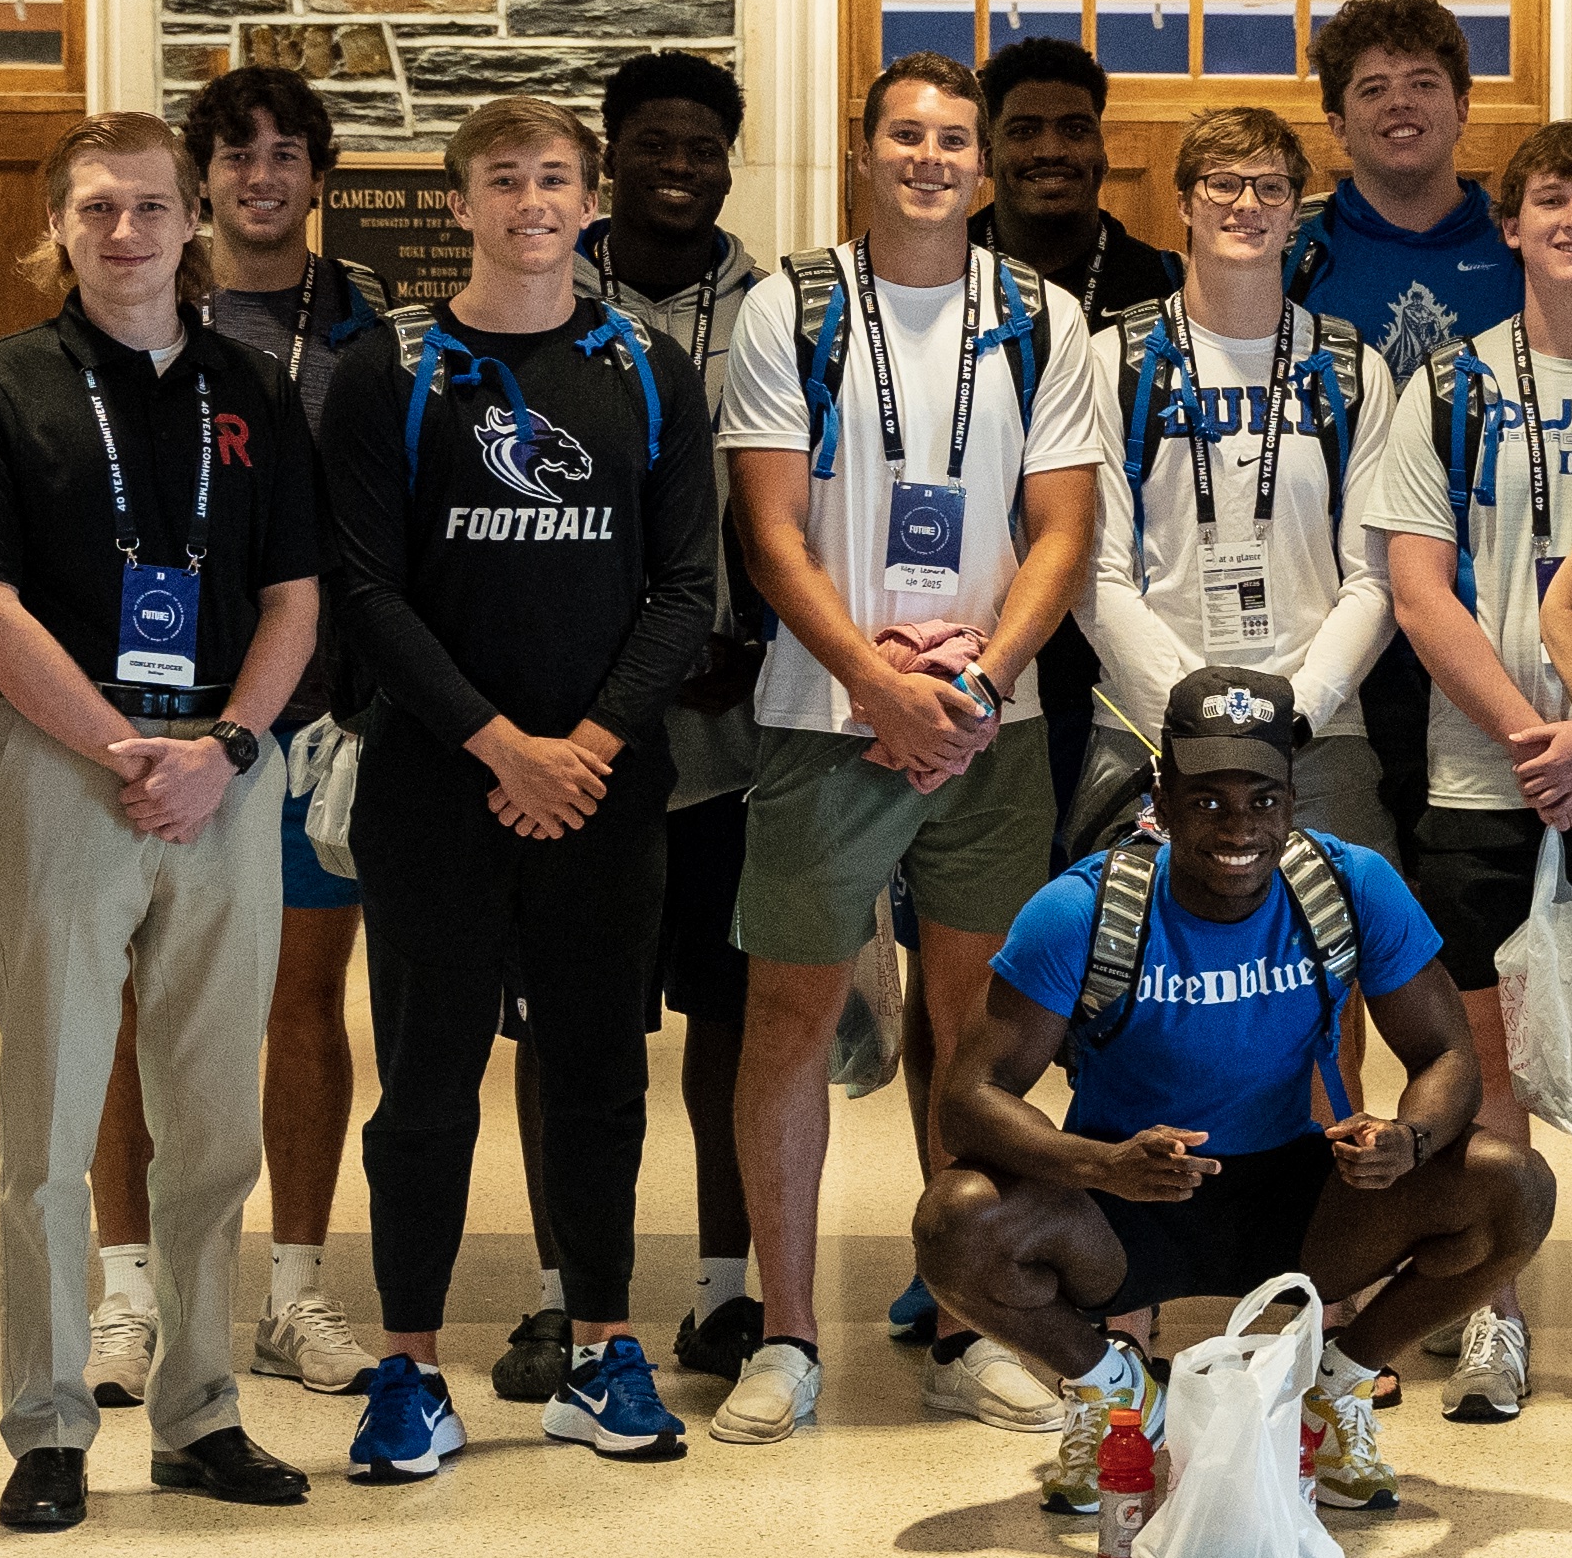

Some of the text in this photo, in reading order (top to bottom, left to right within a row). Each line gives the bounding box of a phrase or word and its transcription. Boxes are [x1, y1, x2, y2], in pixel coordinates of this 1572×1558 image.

[330, 189, 446, 209] CAMERON IND
[397, 281, 468, 298] McCULLOU
[398, 246, 473, 258] DUKE UNIVERS
[869, 320, 895, 434] 40 YEAR COMMITMENT
[954, 336, 975, 451] 40 YEAR COMMITMENT
[91, 396, 126, 512] 40 YEAR COMMITMENT
[196, 401, 212, 518] 40 YEAR COMMITMENT
[214, 413, 253, 468] R
[1261, 385, 1283, 496] 40 YEAR COMMITMENT
[1524, 401, 1544, 511] 40 YEAR COMMITMENT
[446, 507, 613, 541] FOOTBALL
[921, 578, 942, 589] 2025
